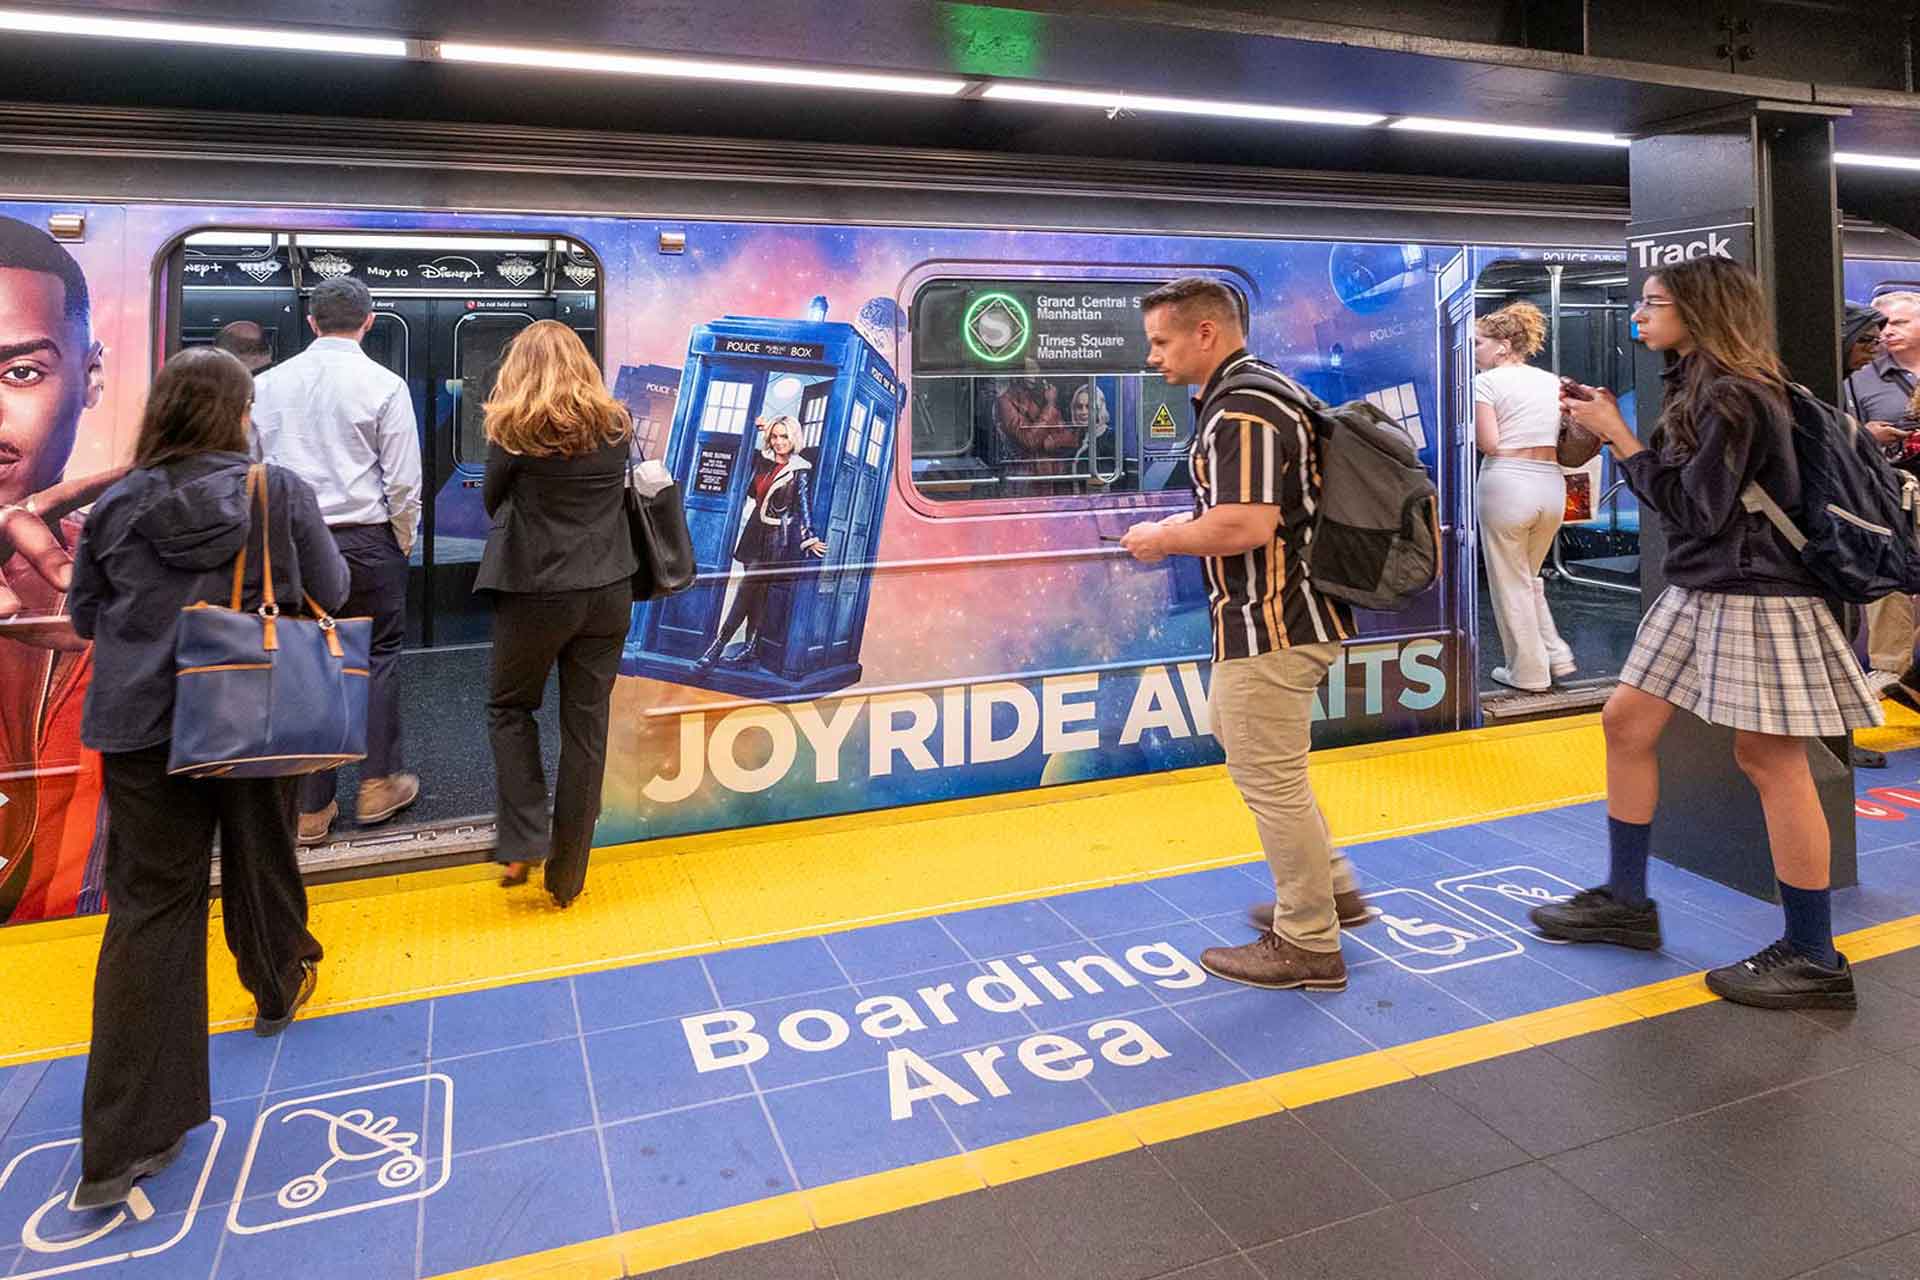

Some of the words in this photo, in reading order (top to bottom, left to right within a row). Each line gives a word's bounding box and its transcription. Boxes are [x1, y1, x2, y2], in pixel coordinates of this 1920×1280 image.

[1631, 232, 1732, 268] Track
[367, 266, 391, 278] May
[395, 268, 408, 278] 10
[417, 256, 484, 283] Disney+
[1037, 296, 1075, 308] Grand
[1082, 296, 1126, 308] Central
[1037, 308, 1102, 321] Manhattan
[727, 341, 760, 354] POLICE
[790, 345, 813, 358] BOX
[1038, 333, 1076, 347] Times
[1081, 333, 1125, 349] Square
[1037, 347, 1102, 360] Manhattan
[642, 671, 1100, 803] JOYRIDE
[1119, 638, 1446, 746] AITS
[680, 941, 1207, 1073] Boarding
[886, 1019, 1172, 1121] Area
